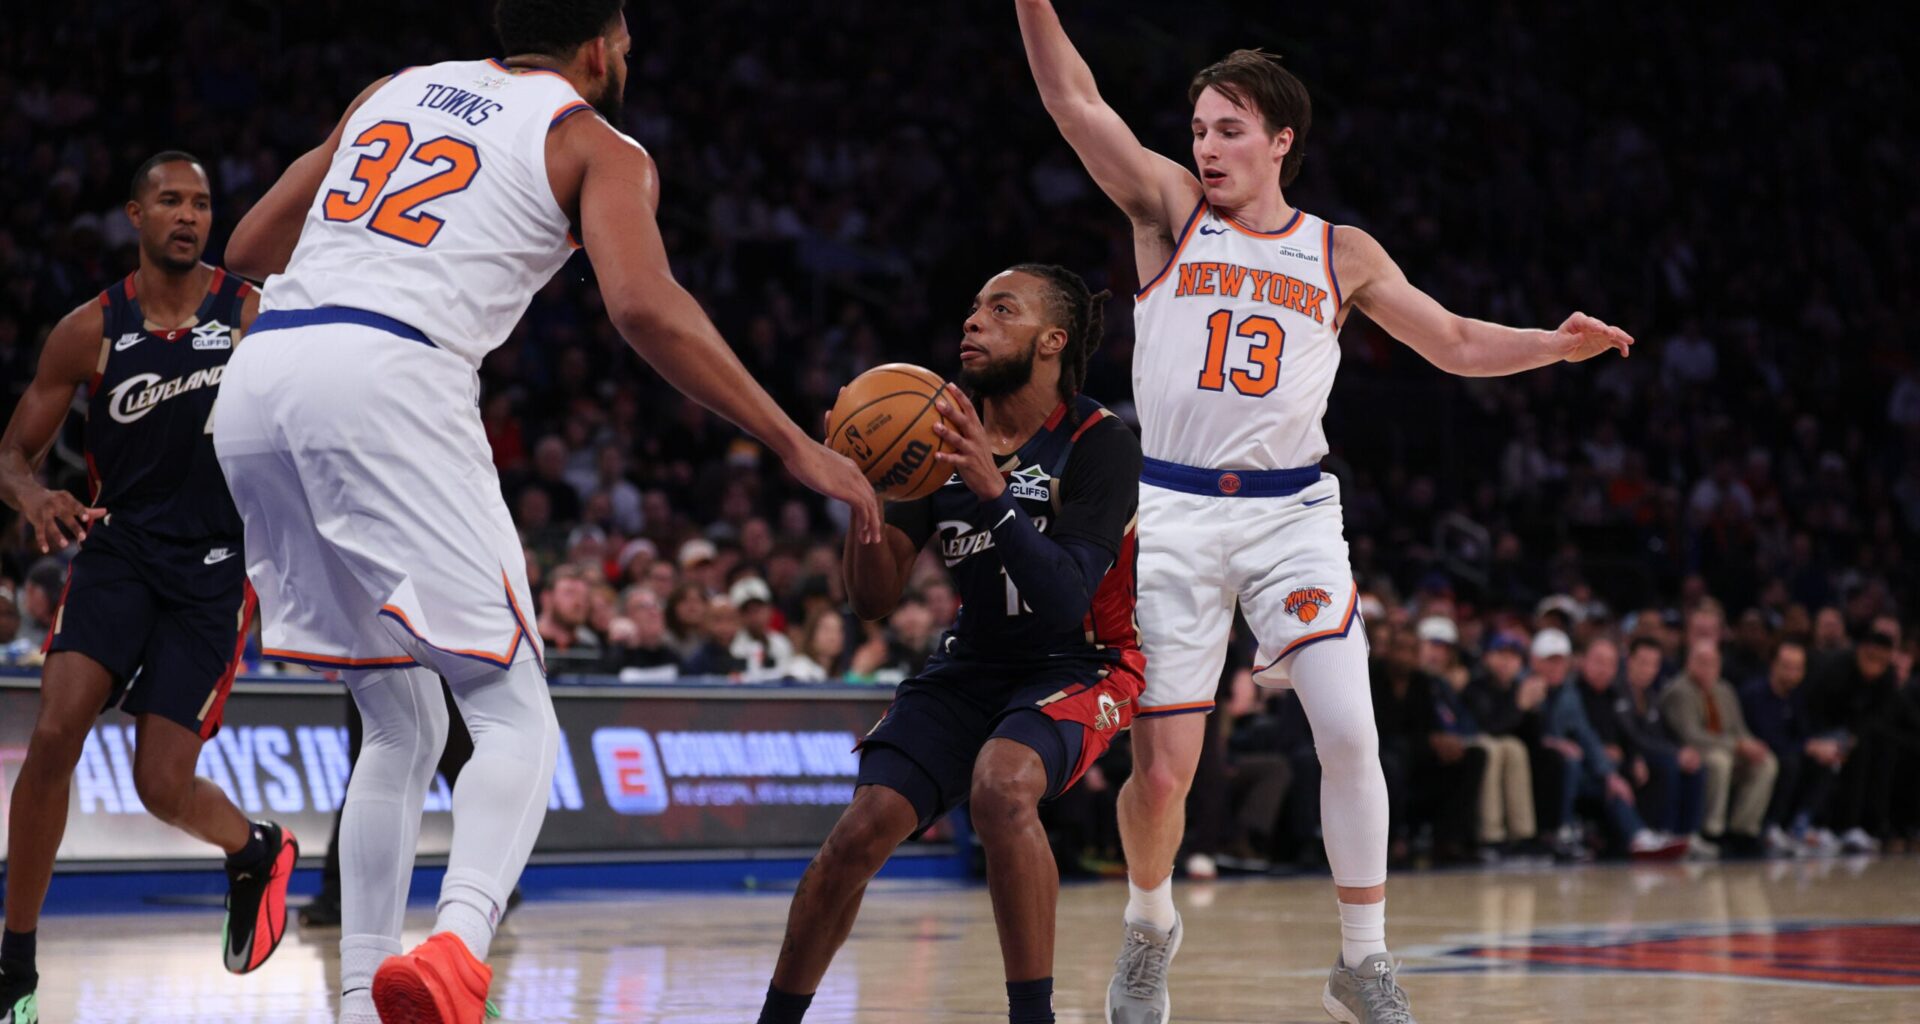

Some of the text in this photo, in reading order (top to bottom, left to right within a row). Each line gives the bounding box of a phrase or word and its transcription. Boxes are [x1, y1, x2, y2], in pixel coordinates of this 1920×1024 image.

[416, 83, 503, 126] TOWNS
[322, 120, 482, 248] 32
[1175, 262, 1328, 324] NEW YORK
[193, 339, 230, 347] CLIFFS
[1198, 308, 1286, 398] 13
[1010, 485, 1049, 499] CLIFFS
[1000, 565, 1033, 616] 1
[74, 725, 304, 813] ALAYS
